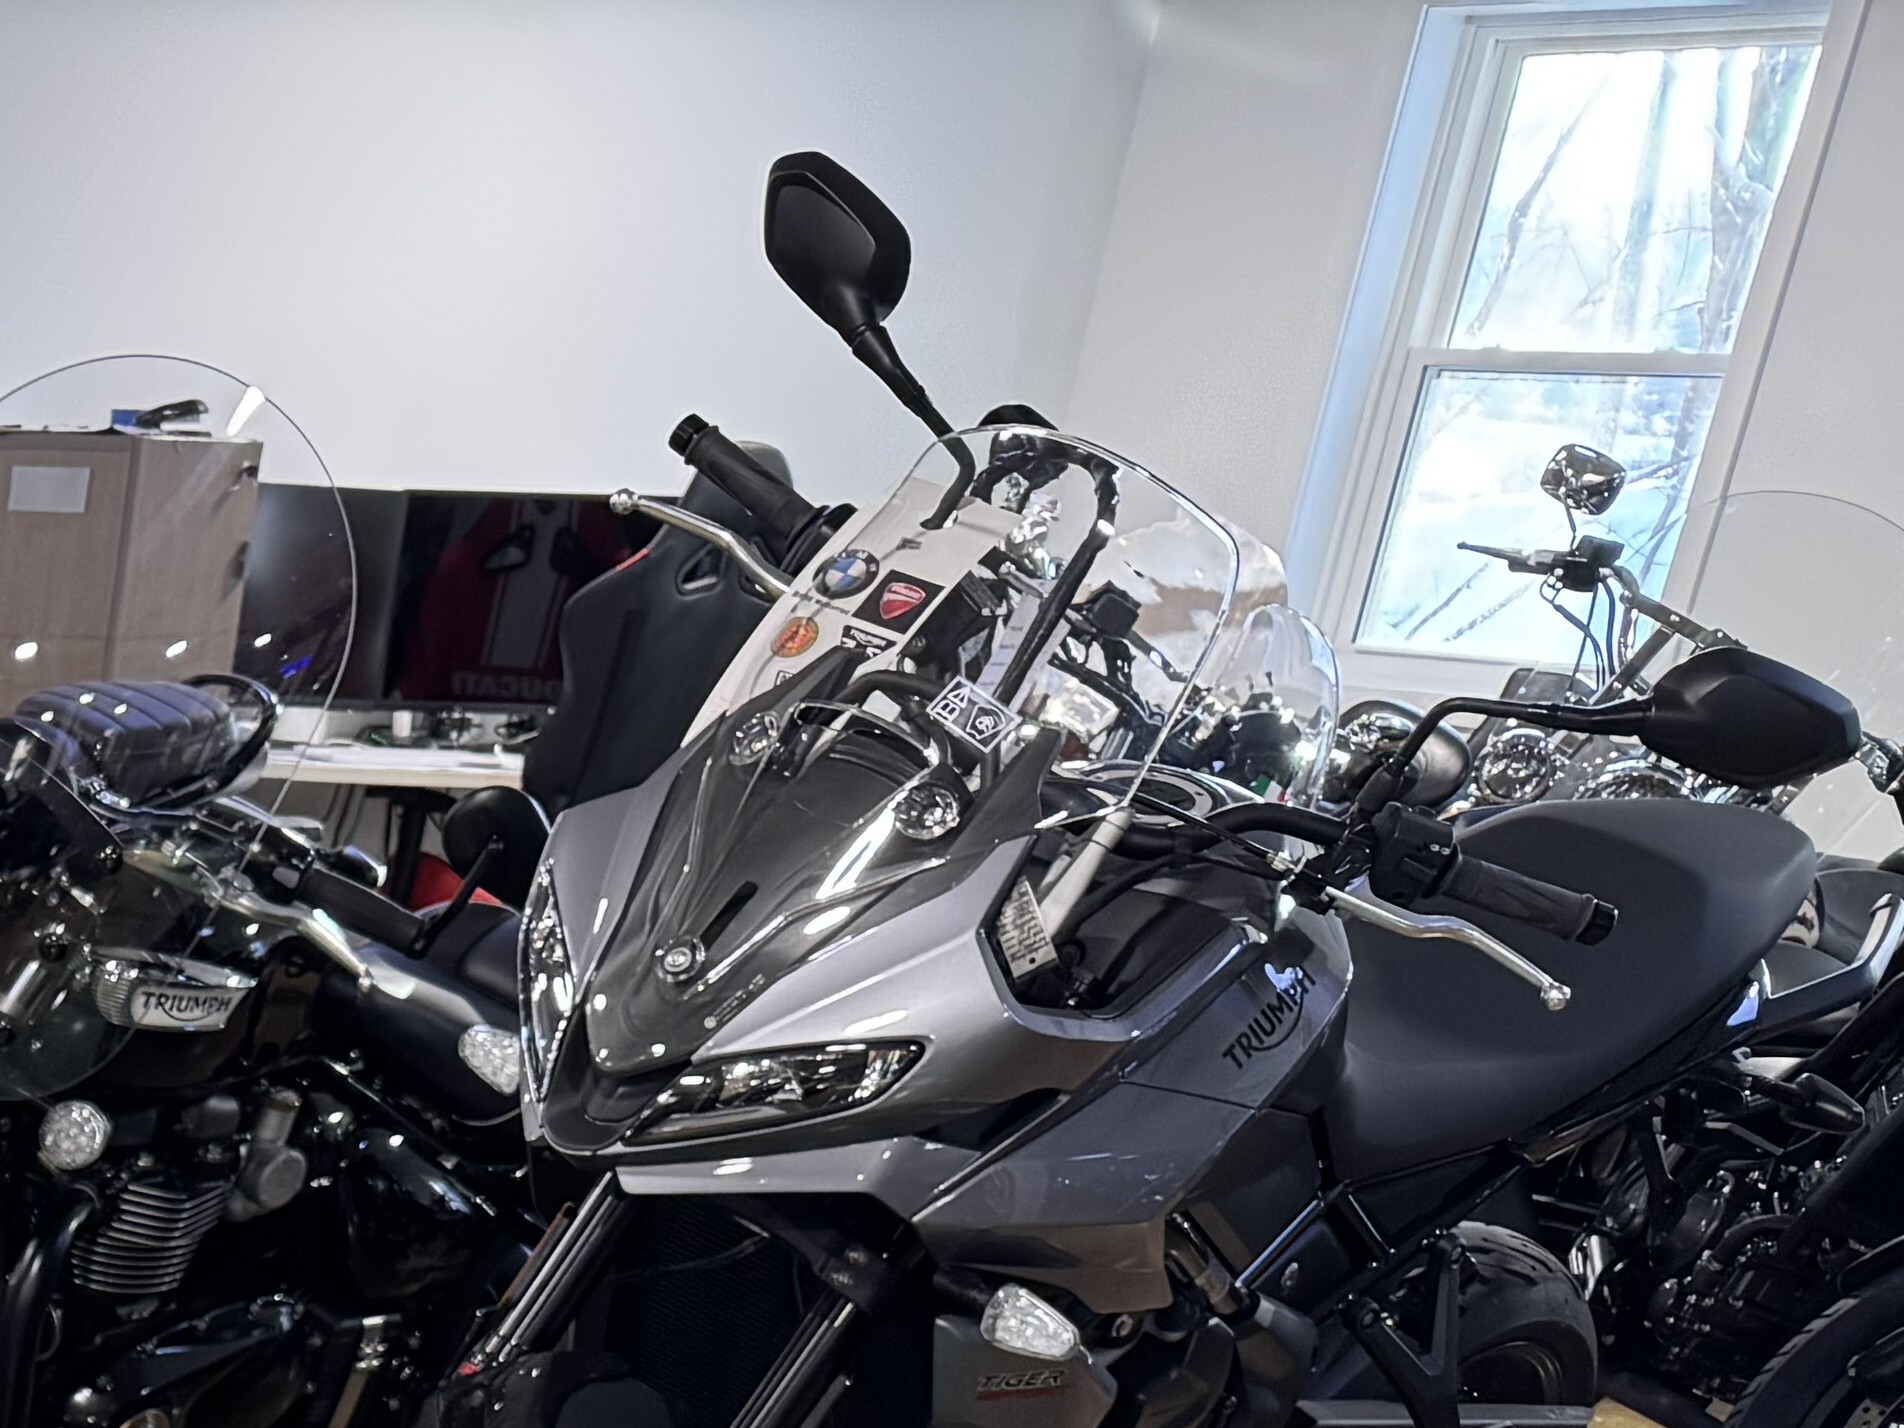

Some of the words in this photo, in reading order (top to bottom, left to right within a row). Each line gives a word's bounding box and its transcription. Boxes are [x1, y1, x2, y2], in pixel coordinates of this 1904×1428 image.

[141, 991, 233, 1021] TRIUMPH
[1222, 964, 1316, 1070] TRIUMPH
[977, 1369, 1067, 1392] TIGER
